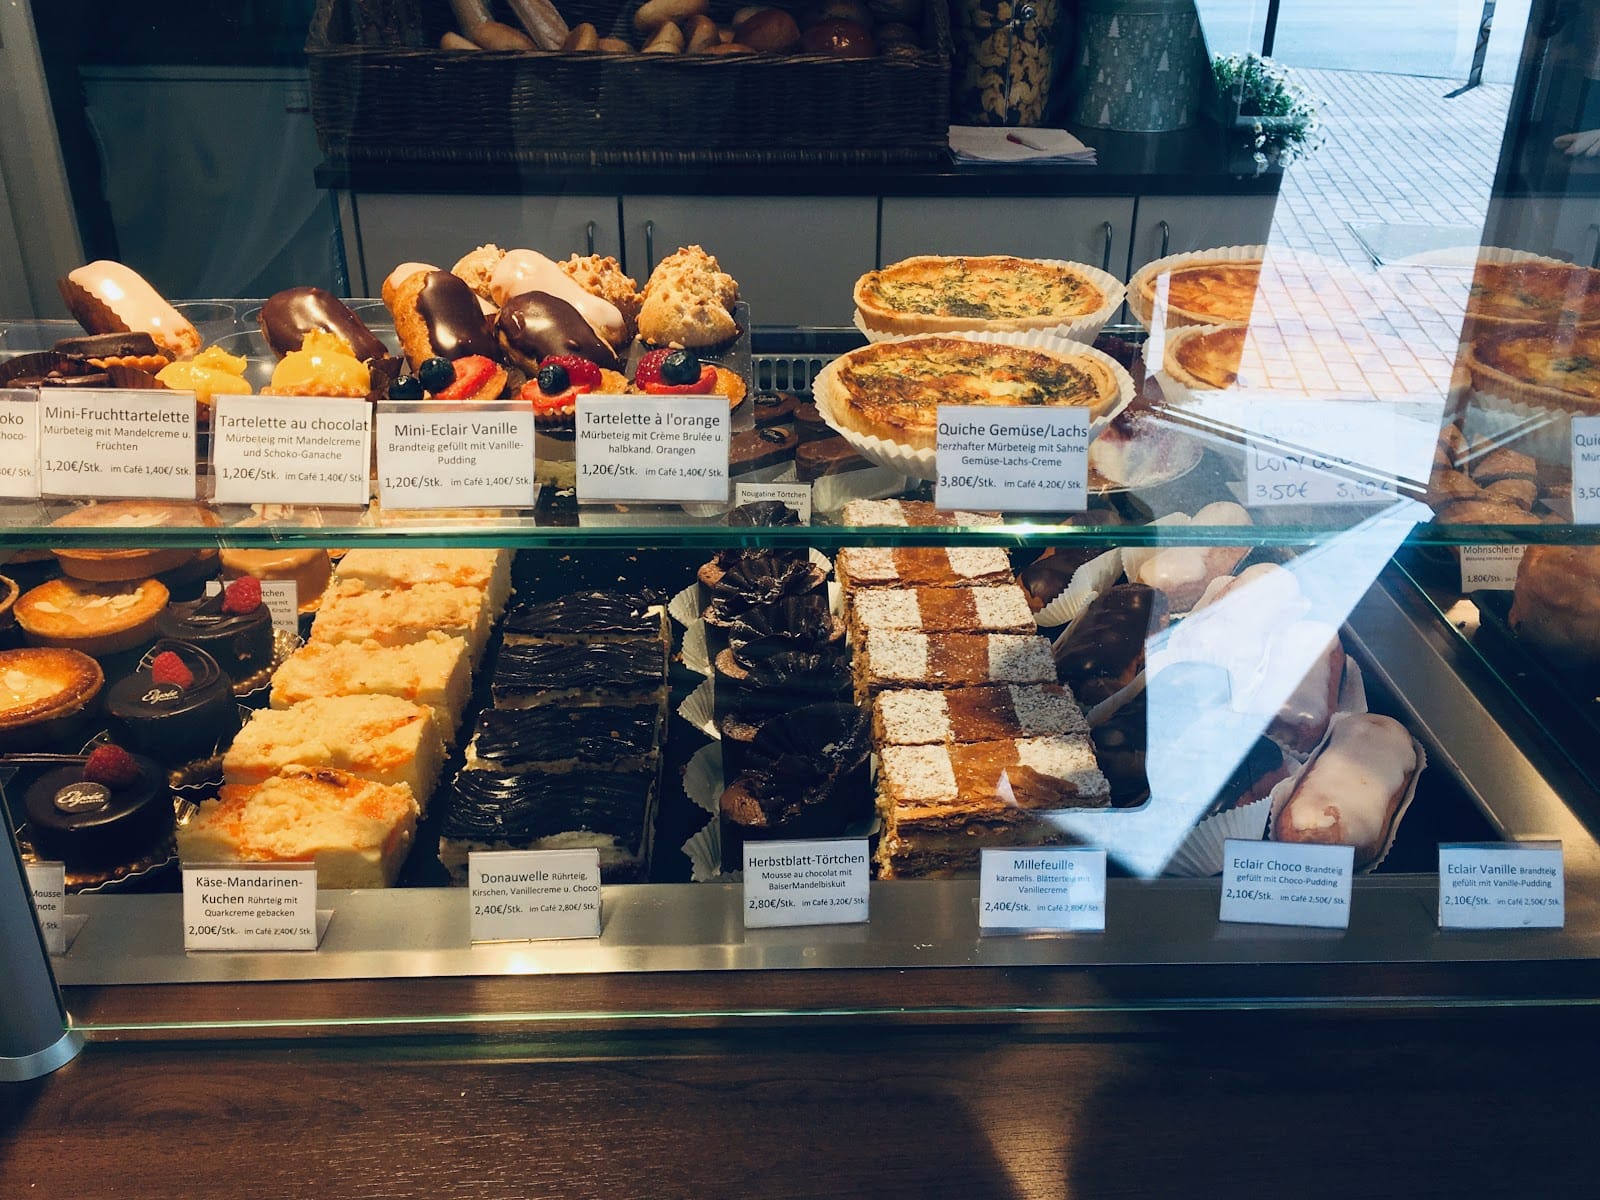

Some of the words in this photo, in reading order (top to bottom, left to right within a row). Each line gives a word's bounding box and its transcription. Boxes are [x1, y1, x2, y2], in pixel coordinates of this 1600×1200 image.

[45, 407, 190, 423] Mini-Fruchttartelette
[585, 412, 650, 424] Tartelette
[655, 414, 662, 424] à
[667, 414, 719, 428] l'orange
[220, 416, 286, 429] Tartelette
[291, 421, 307, 429] au
[312, 419, 368, 431] chocolat
[44, 425, 93, 436] Mürbeteig
[96, 428, 111, 436] mit
[114, 428, 179, 438] Mandelcreme
[395, 424, 468, 436] Mini-Eclair
[472, 423, 518, 435] Vanille
[939, 423, 985, 436] Quiche
[990, 424, 1087, 438] Gemüse/Lachs
[0, 432, 27, 440] hoco-
[226, 434, 275, 444] Mürbeteig
[296, 436, 360, 446] Mandelcreme
[581, 431, 629, 441] Mürbeteig
[651, 431, 680, 440] Crème
[96, 441, 138, 450] Früchten
[389, 443, 434, 452] Brandteig
[437, 442, 467, 452] gefüllt
[489, 441, 523, 450] Vanille-
[609, 445, 653, 454] halbkand.
[656, 446, 696, 456] Orangen
[988, 443, 1036, 453] Mürbeteig
[264, 449, 342, 460] Schoko-Ganache
[438, 456, 477, 465] Pudding
[962, 456, 1062, 466] Gemüse-Lachs-Creme
[0, 468, 16, 476] 0€/
[47, 461, 102, 473] 1,20€/Stk.
[582, 464, 638, 476] 1,20€/Stk.
[658, 468, 677, 476] Café
[223, 468, 279, 480] 1,20€/Stk.
[385, 476, 443, 488] 1,20€/Stk.
[940, 476, 996, 488] 3,80€/Stk.
[1017, 480, 1036, 488] Café
[1464, 545, 1519, 554] Mohnschleife
[749, 854, 864, 867] Herbstblatt-Törtchen
[1014, 860, 1074, 870] Millefeuille
[1234, 859, 1264, 870] Eclair
[1267, 861, 1301, 872] Choco
[1305, 866, 1343, 875] Brandteig
[1448, 864, 1477, 874] Eclair
[1480, 864, 1517, 874] Vanille
[1520, 868, 1556, 876] Brandteig
[196, 877, 302, 887] Käse-Mandarinen-
[482, 871, 548, 883] Donauwelle
[552, 872, 588, 881] Rührteig,
[1237, 874, 1261, 882] gefüllt
[1279, 877, 1338, 888] Choco-Pudding
[769, 880, 846, 890] BaiserMandelbiskuit
[1453, 879, 1476, 888] gefüllt
[1494, 880, 1552, 888] Vanille-Pudding
[472, 888, 508, 896] Kirschen,
[510, 887, 561, 895] Vanillecreme
[1226, 889, 1273, 900] 2,10€/Stk.
[202, 894, 244, 904] Kuchen
[248, 897, 282, 905] Rührteig
[749, 898, 795, 909] 2,80€/Stk.
[1445, 896, 1491, 906] 2,10€/Stk.
[475, 904, 522, 915] 2,40€/Stk.
[985, 902, 1030, 912] 2,40€/Stk.
[256, 910, 294, 918] gebacken
[189, 925, 237, 936] 2,00€/Stk.
